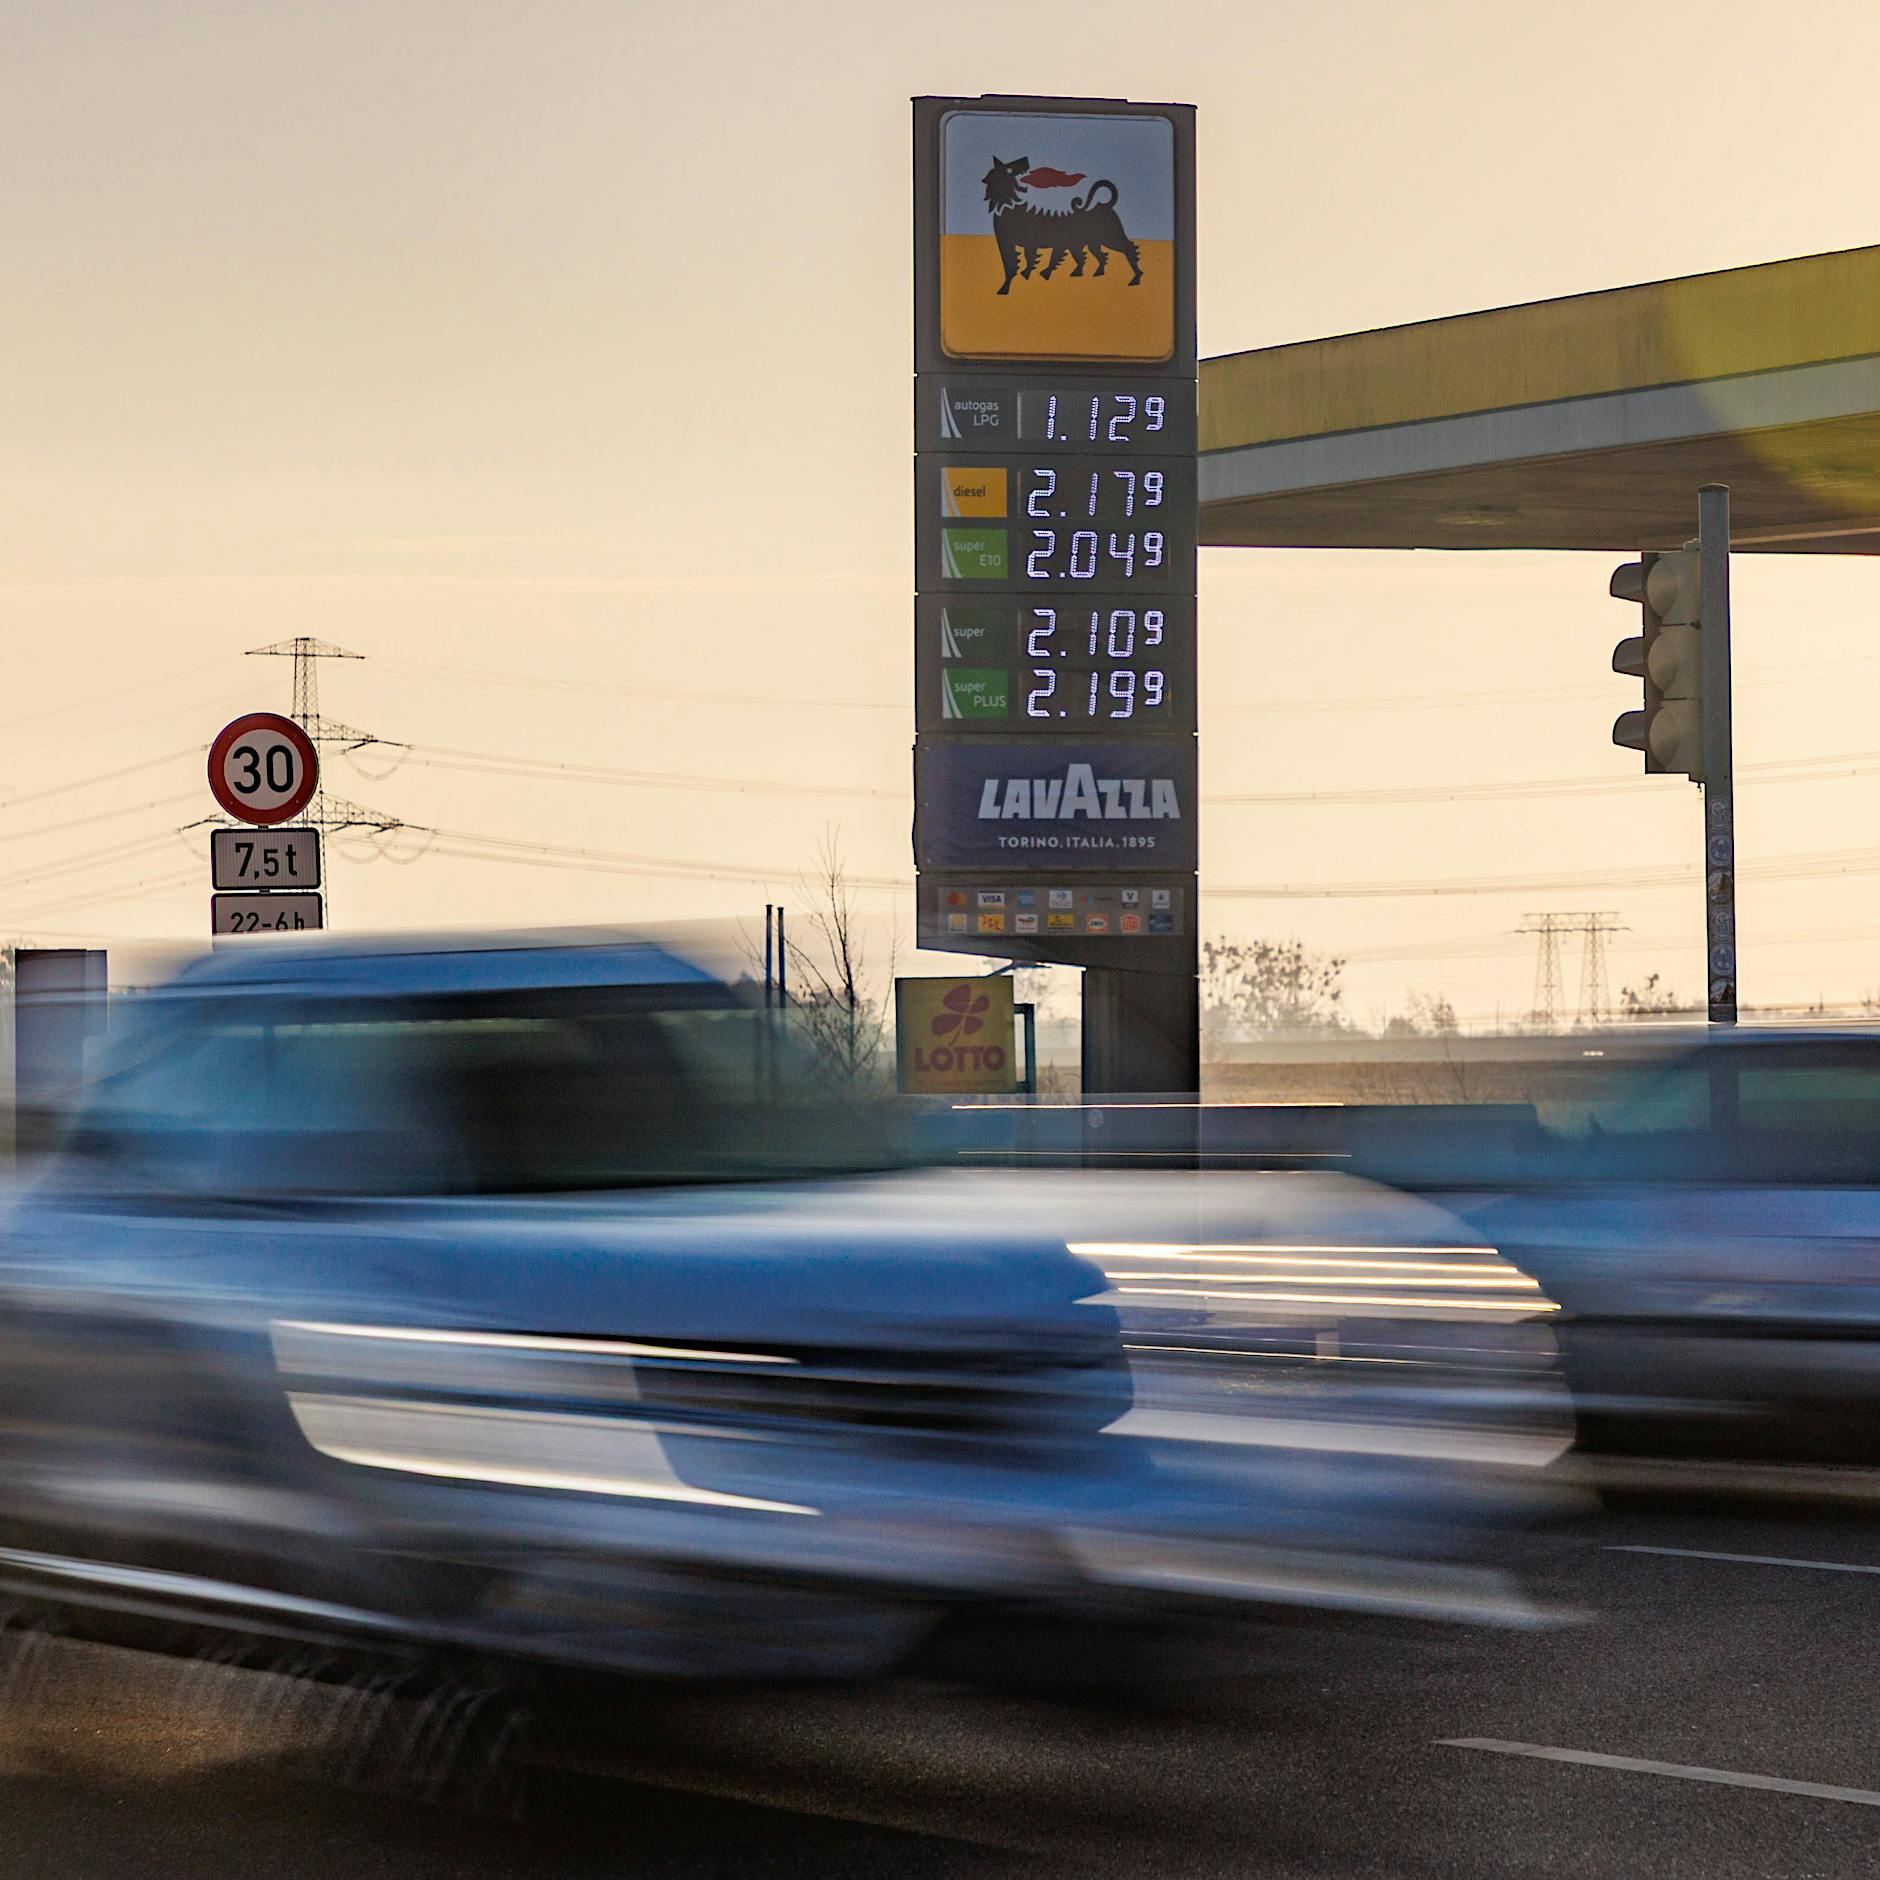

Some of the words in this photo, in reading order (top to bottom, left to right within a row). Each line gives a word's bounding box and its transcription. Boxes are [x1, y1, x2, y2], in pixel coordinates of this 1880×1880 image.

[954, 400, 999, 412] autogas
[973, 414, 999, 426] LPG
[1046, 395, 1165, 441] 1.129
[953, 486, 986, 497] diesel
[1027, 469, 1164, 517] 2.179
[954, 542, 985, 553] super
[1026, 530, 1163, 578] 2.049
[979, 556, 1000, 566] E10
[954, 628, 985, 639] super
[1027, 609, 1164, 657] 2.109
[954, 682, 986, 693] super
[1027, 669, 1164, 717] 2.199
[974, 696, 1007, 707] PLUS
[232, 744, 294, 794] 30
[978, 763, 1181, 819] LAVAZZA
[982, 895, 1002, 903] VISA
[914, 1046, 1007, 1072] LOTTO
